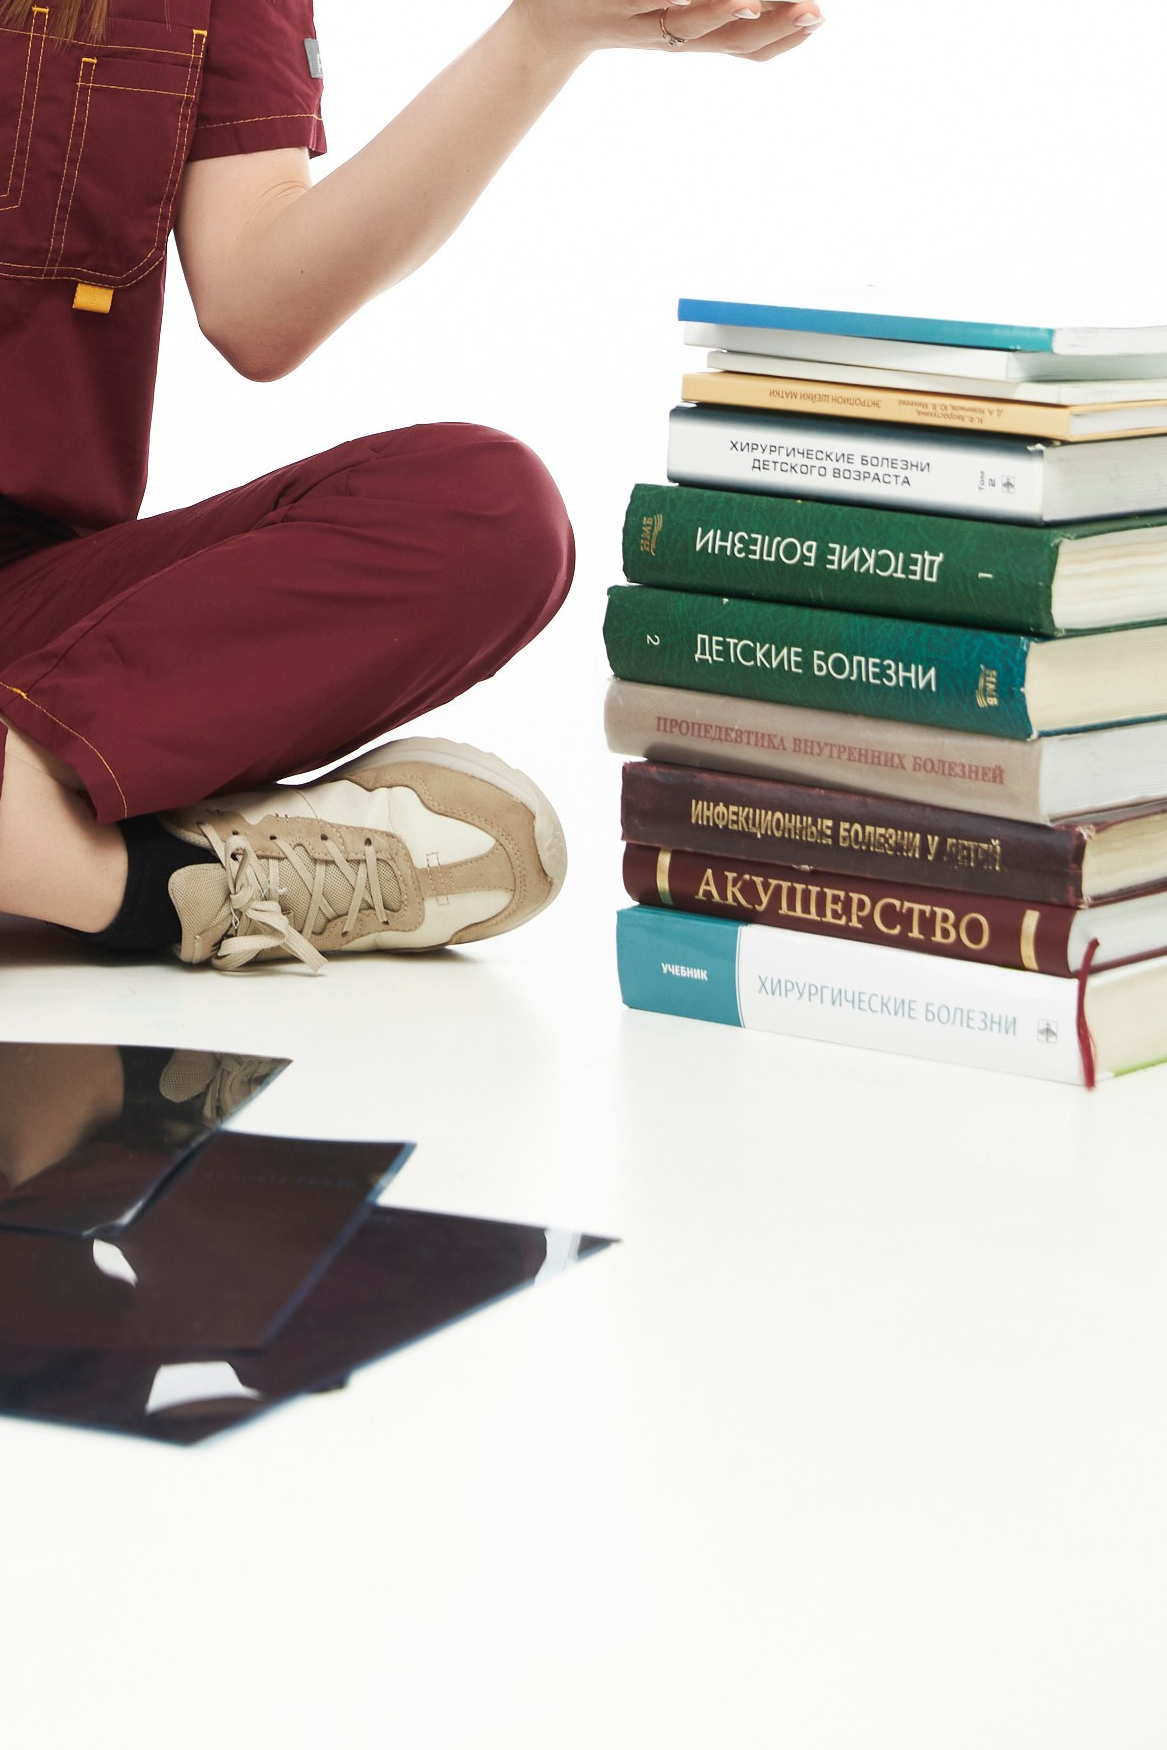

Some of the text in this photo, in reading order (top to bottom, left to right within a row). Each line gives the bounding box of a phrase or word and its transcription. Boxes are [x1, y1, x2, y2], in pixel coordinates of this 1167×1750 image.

[769, 388, 882, 409] ЭКТРОПИОН ШЕЙКИ МАТКИ
[729, 439, 930, 473] ХИРУРГИЧЕСКИЕ БОЛЕЗНИ
[751, 457, 912, 488] ДЕТСКОГО ВОЗРАСТА
[695, 526, 944, 582] ДЕТСКИЕ БОЛЕЗНИ
[646, 634, 660, 646] 2
[695, 633, 937, 692] ДЕТСКИЕ БОЛЕЗНИ
[656, 716, 1005, 785] ПРОПЕДЕВТИКА ВНУТРЕННИХ БОЛЕЗНЕЙ
[691, 799, 833, 847] ИНФЕКЦИОННЫЕ
[839, 821, 921, 860] БОЛЕЗНИ
[927, 834, 939, 861] У
[695, 868, 990, 950] АКУШЕРСТВО
[661, 962, 708, 982] УЧЕБНИК
[757, 974, 1018, 1037] ХИРУРГИЧЕСКИЕ БОЛЕЗНИ
